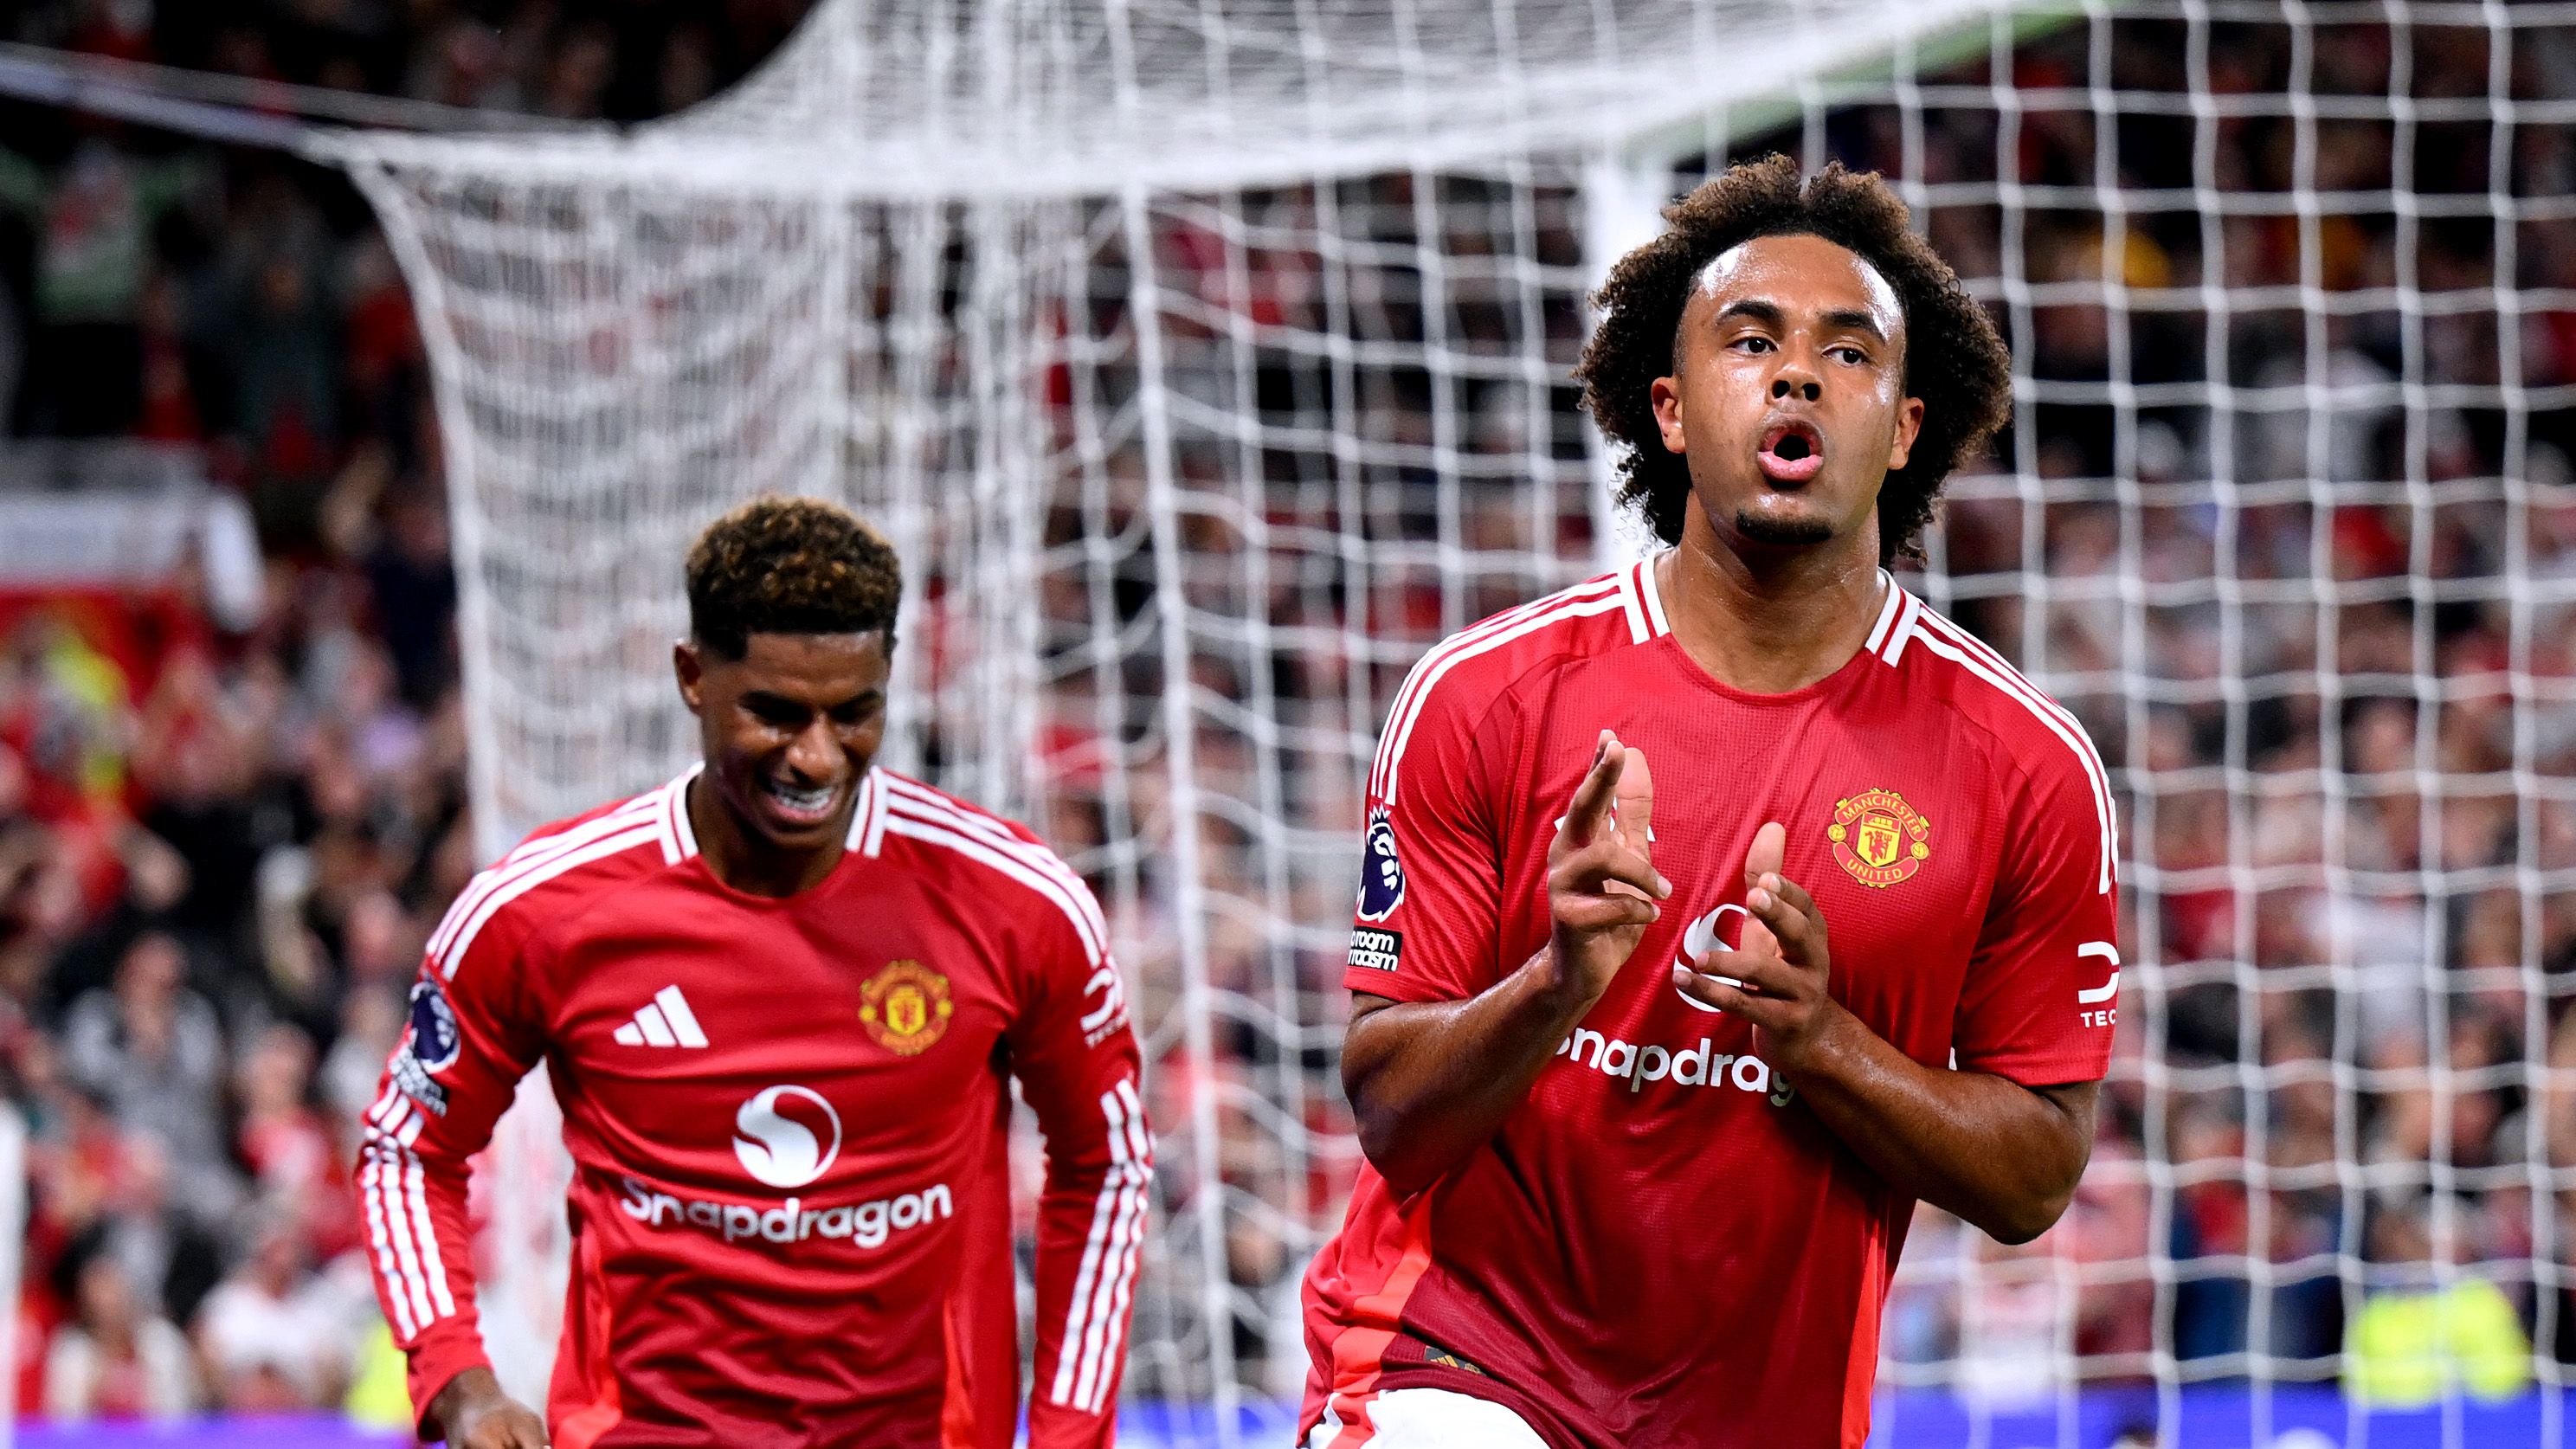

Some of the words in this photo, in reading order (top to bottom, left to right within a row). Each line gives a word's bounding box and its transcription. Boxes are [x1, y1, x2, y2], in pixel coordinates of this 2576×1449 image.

[1842, 795, 1921, 835] MANCHESTER
[1847, 859, 1903, 880] UNITED
[1356, 931, 1394, 952] room
[1555, 1027, 1795, 1107] napdrag
[620, 1176, 953, 1249] Snapdragon
